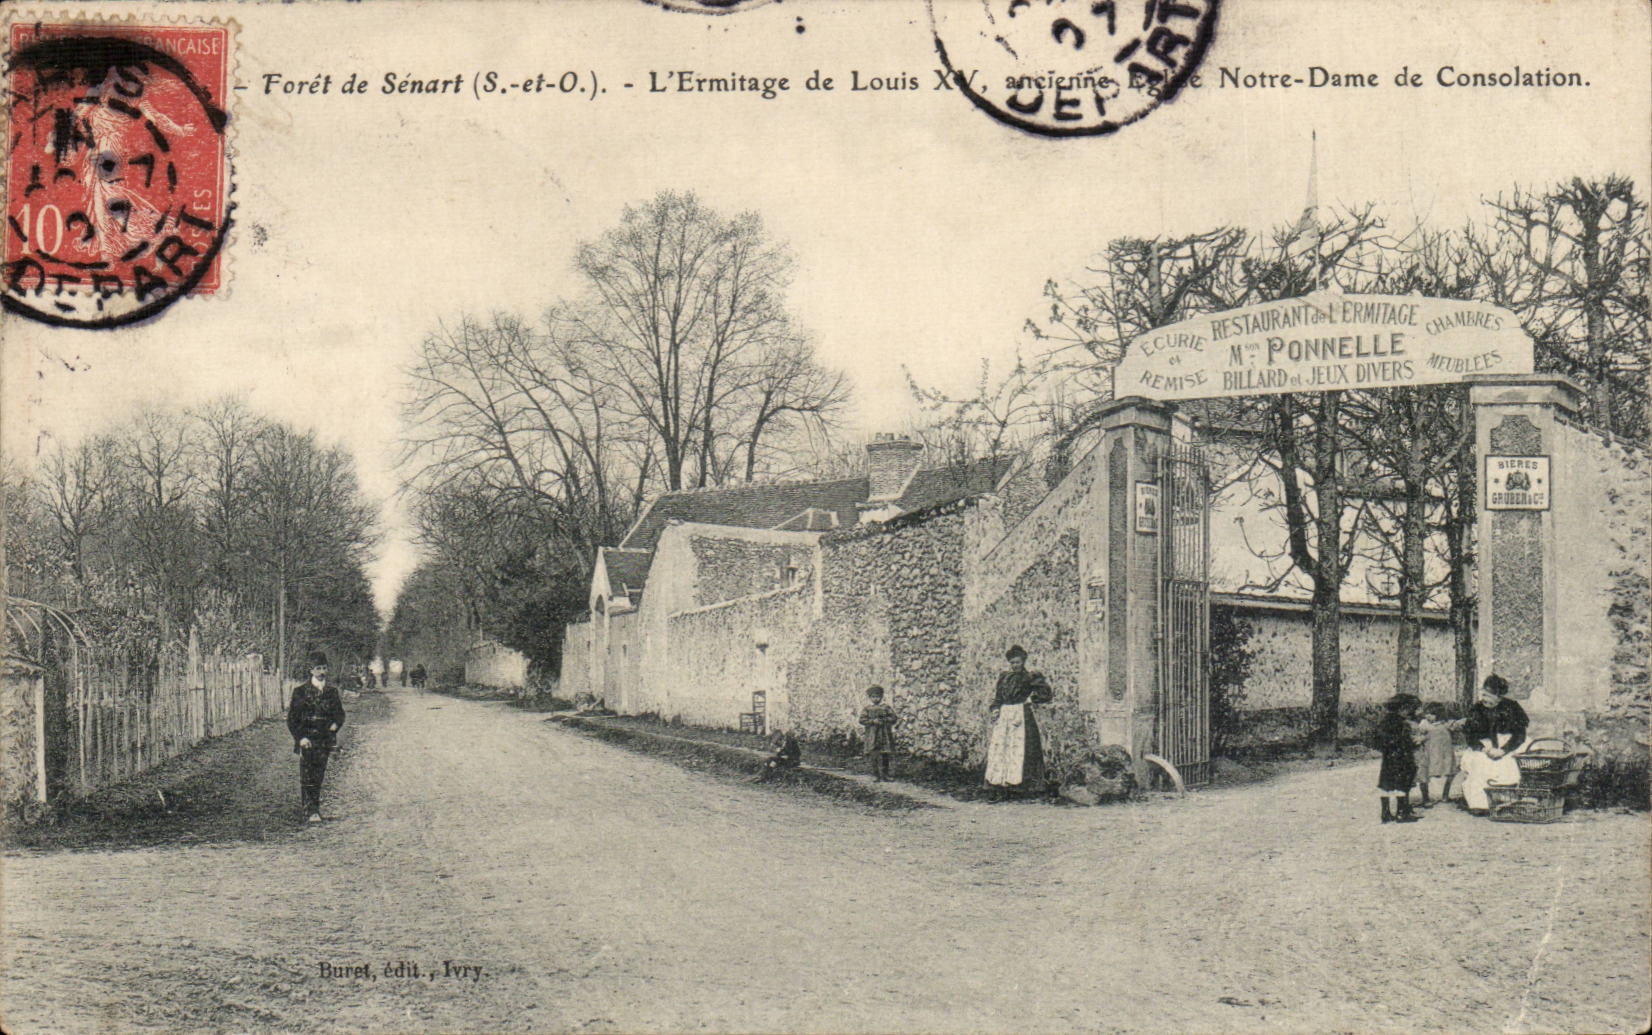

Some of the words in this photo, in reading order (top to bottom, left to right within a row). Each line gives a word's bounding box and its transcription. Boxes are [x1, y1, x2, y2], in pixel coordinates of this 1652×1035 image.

[15, 203, 64, 256] 10
[1210, 304, 1310, 341] RESTAURANT
[1425, 310, 1504, 337] CHAMBRES
[1140, 333, 1208, 357] ECURIE
[1266, 333, 1406, 366] PONNELLE
[1139, 368, 1209, 391] REMISE
[1223, 368, 1288, 391] BILLARD
[1306, 363, 1350, 386] JEUX
[1356, 359, 1415, 384] DIVERS
